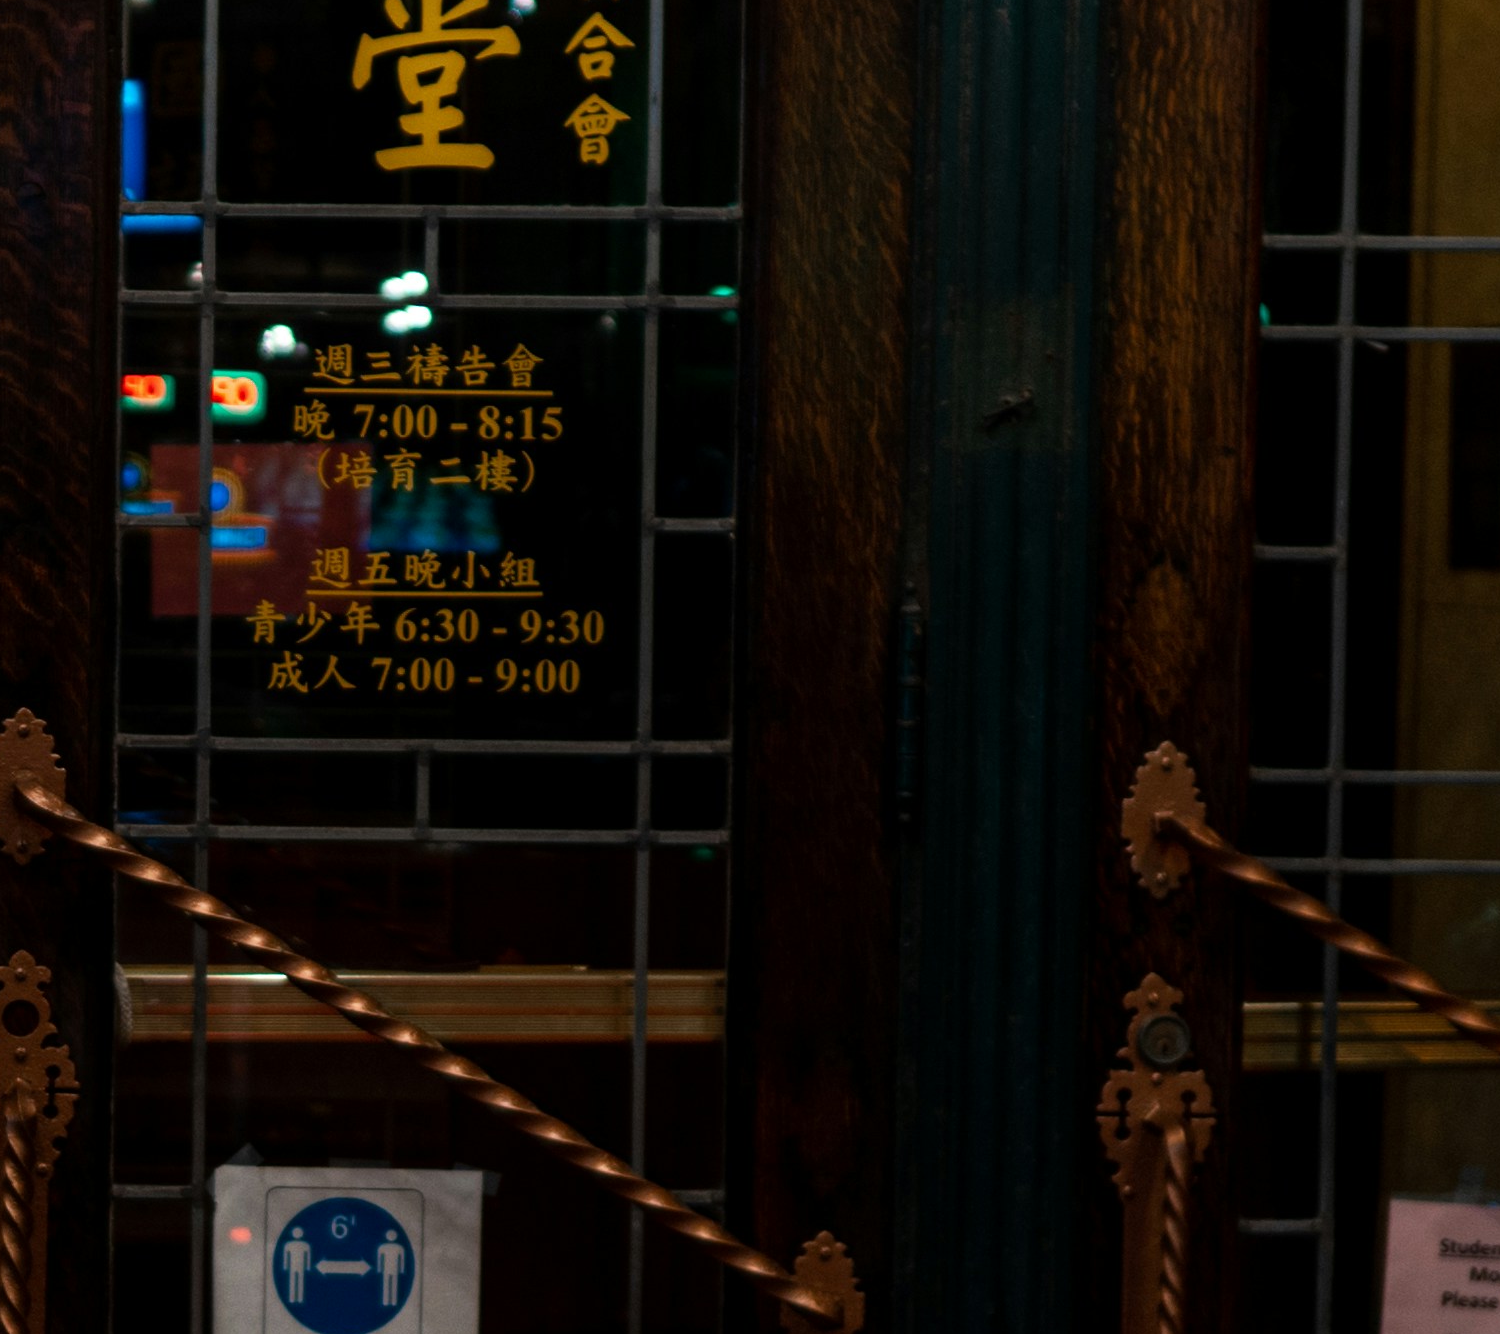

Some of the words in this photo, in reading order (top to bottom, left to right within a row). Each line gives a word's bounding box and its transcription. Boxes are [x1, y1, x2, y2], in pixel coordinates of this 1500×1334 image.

[311, 342, 544, 387] 週三禱告會
[292, 398, 337, 441] 晚
[352, 402, 439, 440] 7:00
[477, 404, 564, 442] 8:15
[317, 447, 536, 494] (培育二樓)
[307, 545, 541, 591] 週五晚小組
[246, 597, 381, 646] 青少年
[393, 607, 481, 644] 6:30
[519, 608, 605, 645] 9:30
[267, 649, 357, 694] 成人
[370, 656, 456, 692] 7:00
[494, 658, 581, 694] 9:00
[1440, 1291, 1498, 1310] Please
